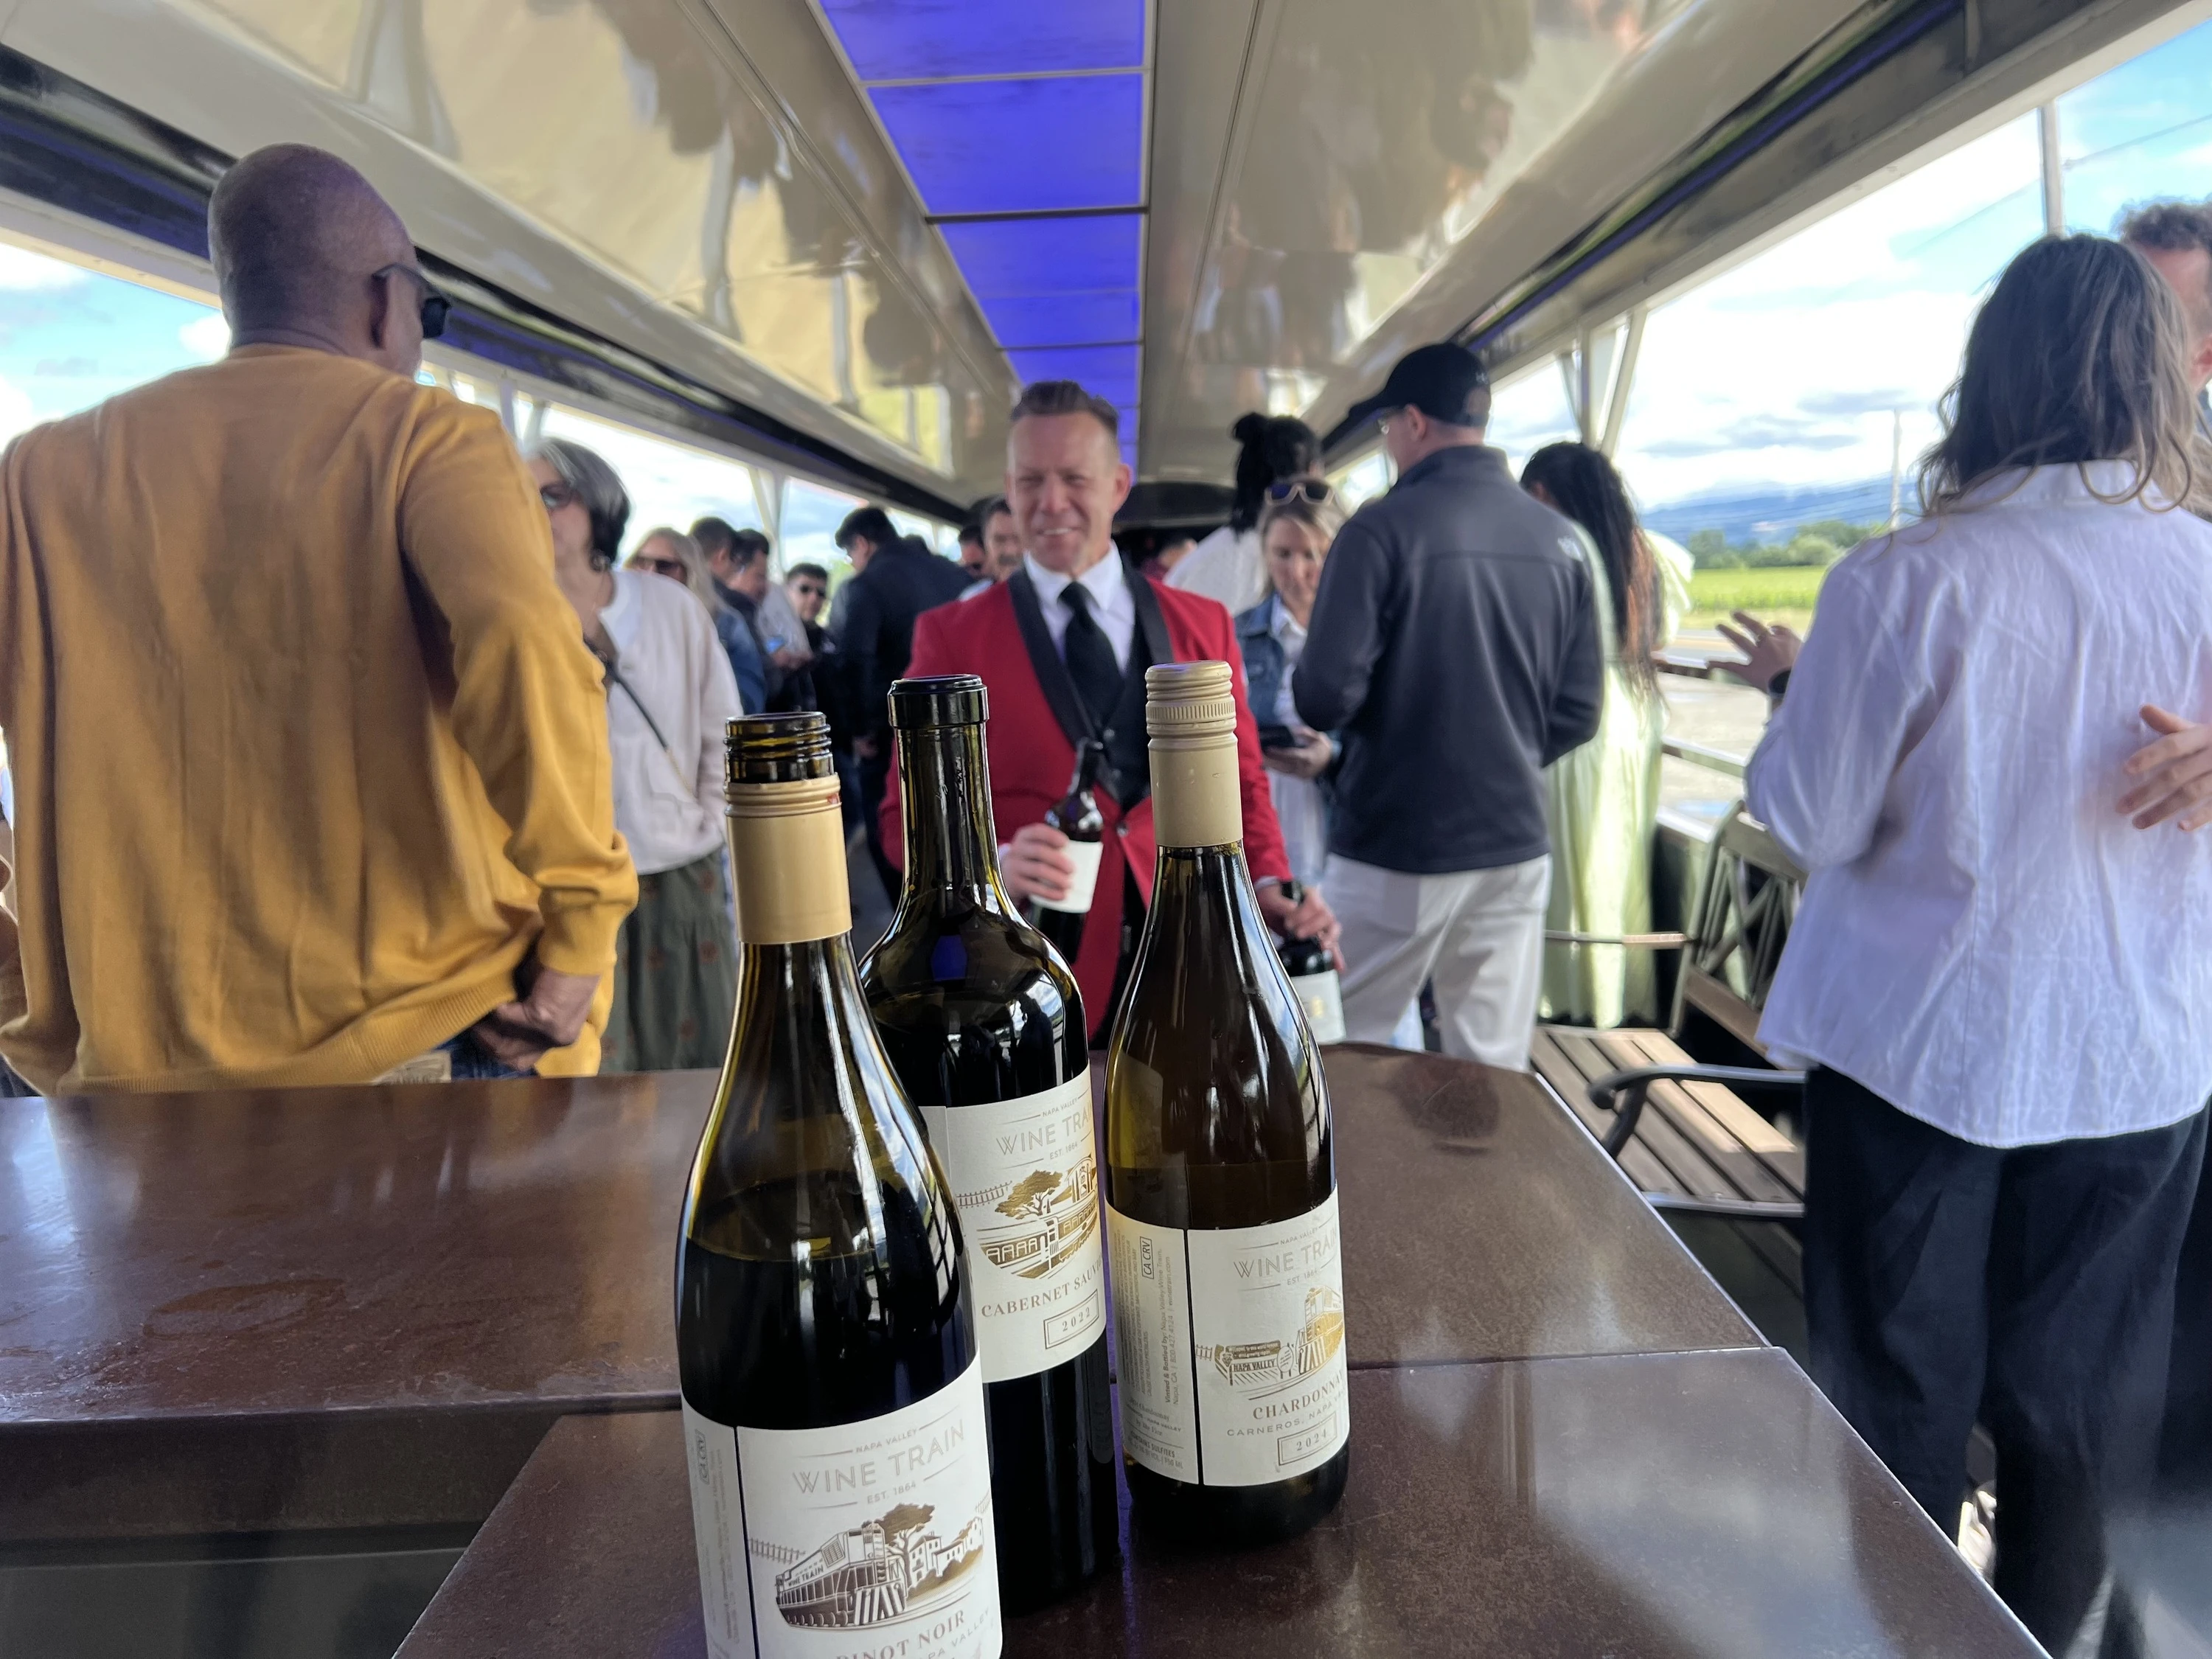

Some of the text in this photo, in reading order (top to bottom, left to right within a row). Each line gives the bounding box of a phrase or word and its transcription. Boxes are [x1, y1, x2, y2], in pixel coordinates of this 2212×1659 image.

[1042, 1098, 1077, 1118] NAPA VALLEY
[995, 1124, 1056, 1155] WINE
[1065, 1142, 1078, 1153] 1864
[1280, 1227, 1318, 1245] NAPA VALLEY
[1142, 1240, 1152, 1275] CA CRV
[1233, 1251, 1293, 1279] WINE
[981, 1282, 1071, 1318] CABERNET
[1062, 1307, 1091, 1332] 2022
[1171, 1372, 1178, 1382] CA
[1252, 1359, 1276, 1371] VALLEY
[1309, 1401, 1332, 1420] NAPA
[855, 1429, 918, 1453] NAPA VALLEY
[1152, 1443, 1175, 1458] SULFITES
[792, 1419, 964, 1494] WINE TRAIN
[866, 1481, 917, 1505] EST. 1864
[801, 1564, 824, 1581] TRAIN
[917, 1610, 965, 1649] NOIR
[950, 1607, 990, 1648] VALLEY
